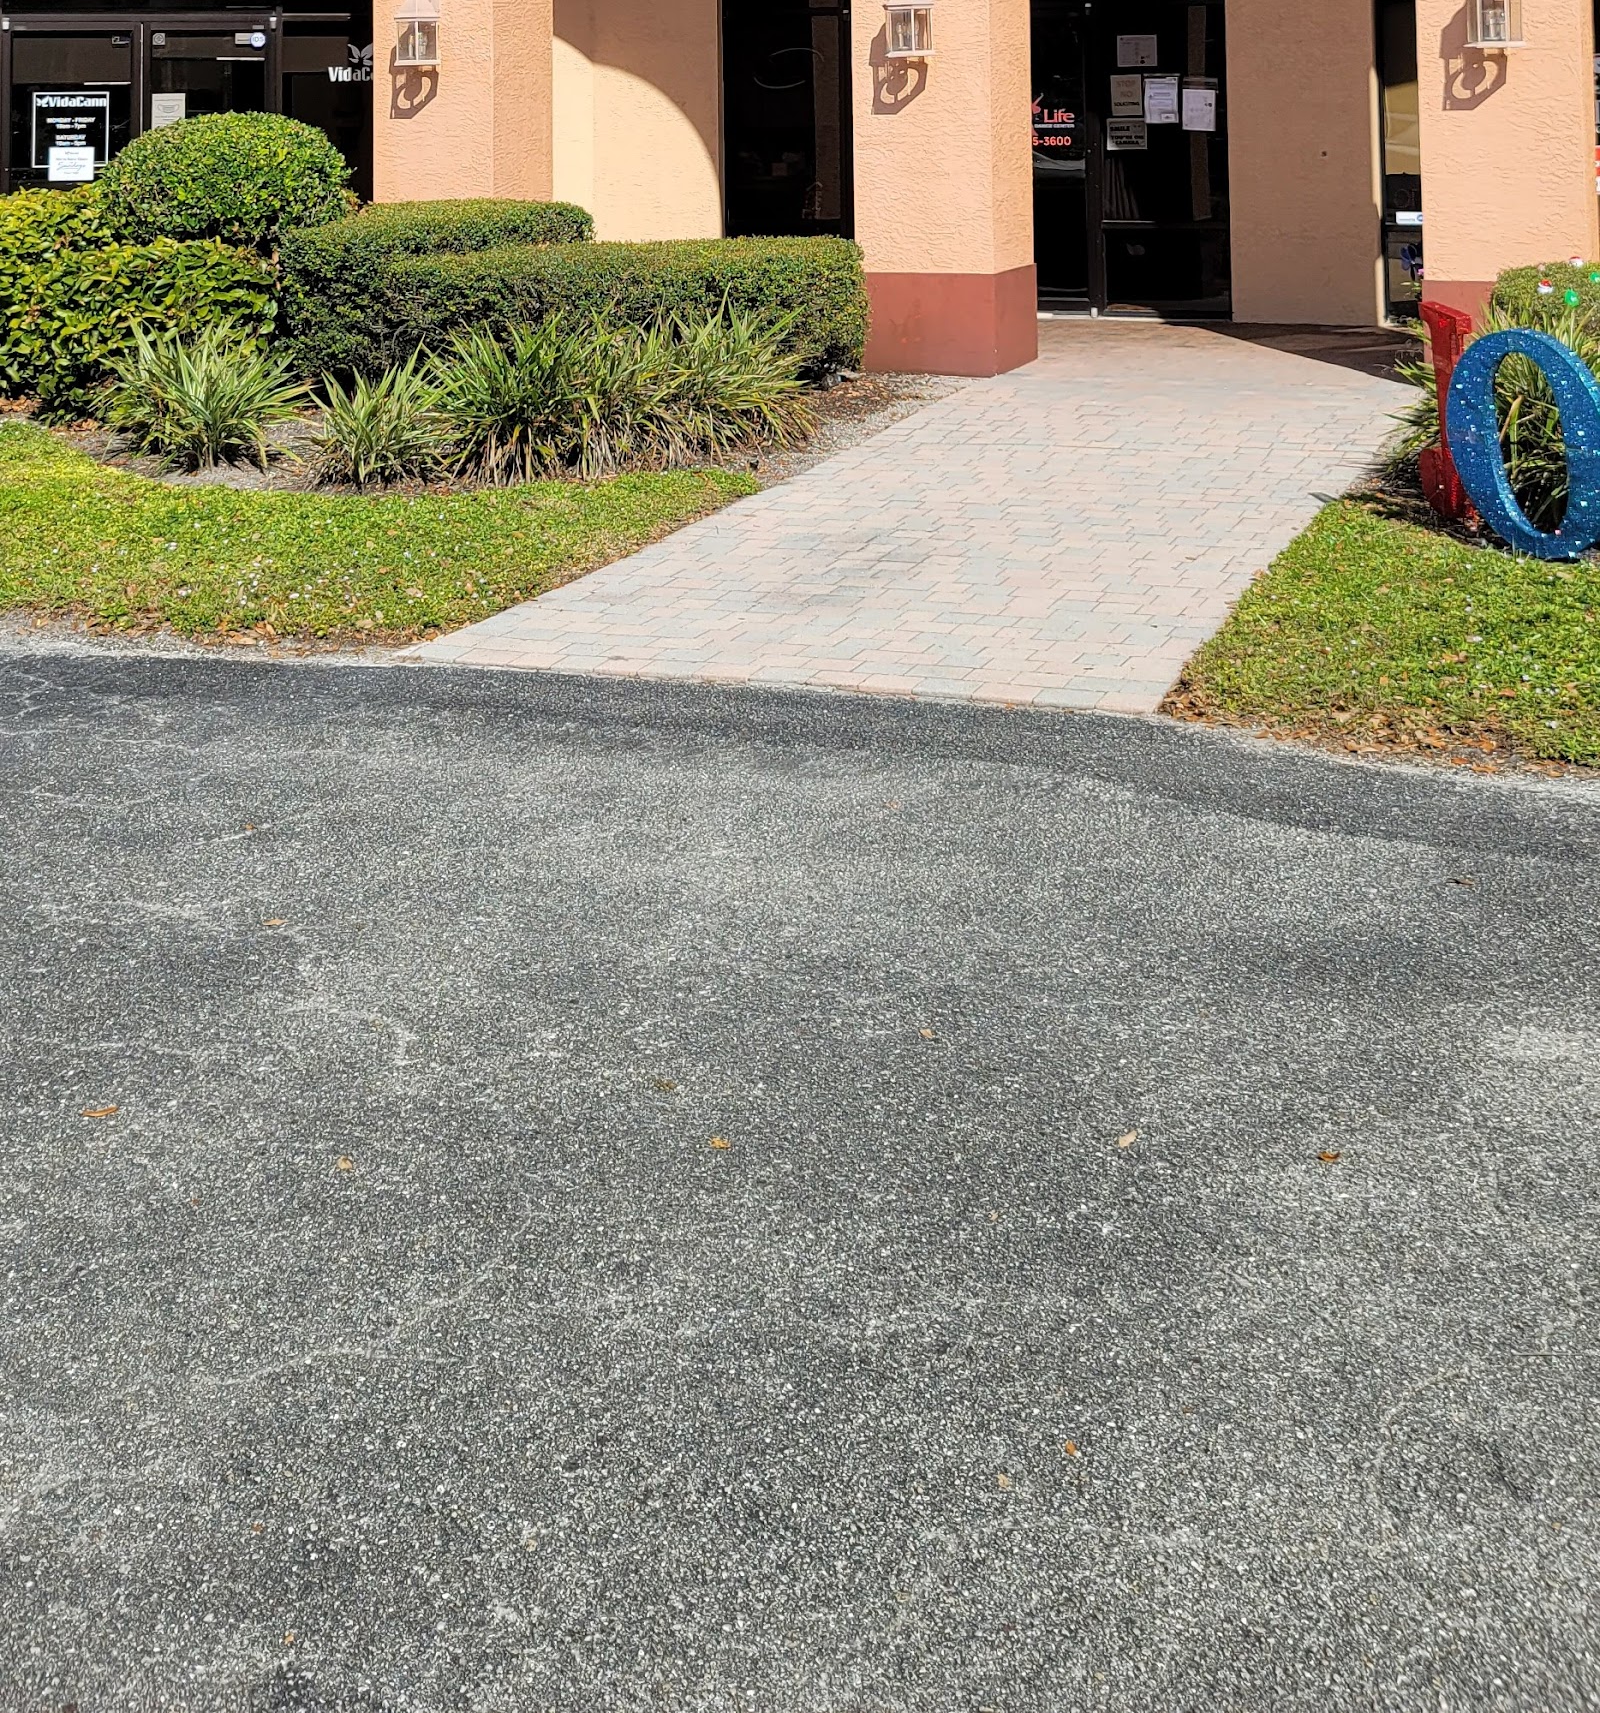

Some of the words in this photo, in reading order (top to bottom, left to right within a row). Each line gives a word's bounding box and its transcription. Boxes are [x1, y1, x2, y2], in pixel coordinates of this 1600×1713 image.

[328, 66, 373, 82] VidaC
[48, 96, 107, 107] VidaCann
[1043, 108, 1075, 123] Life
[1032, 136, 1072, 146] 5-3600
